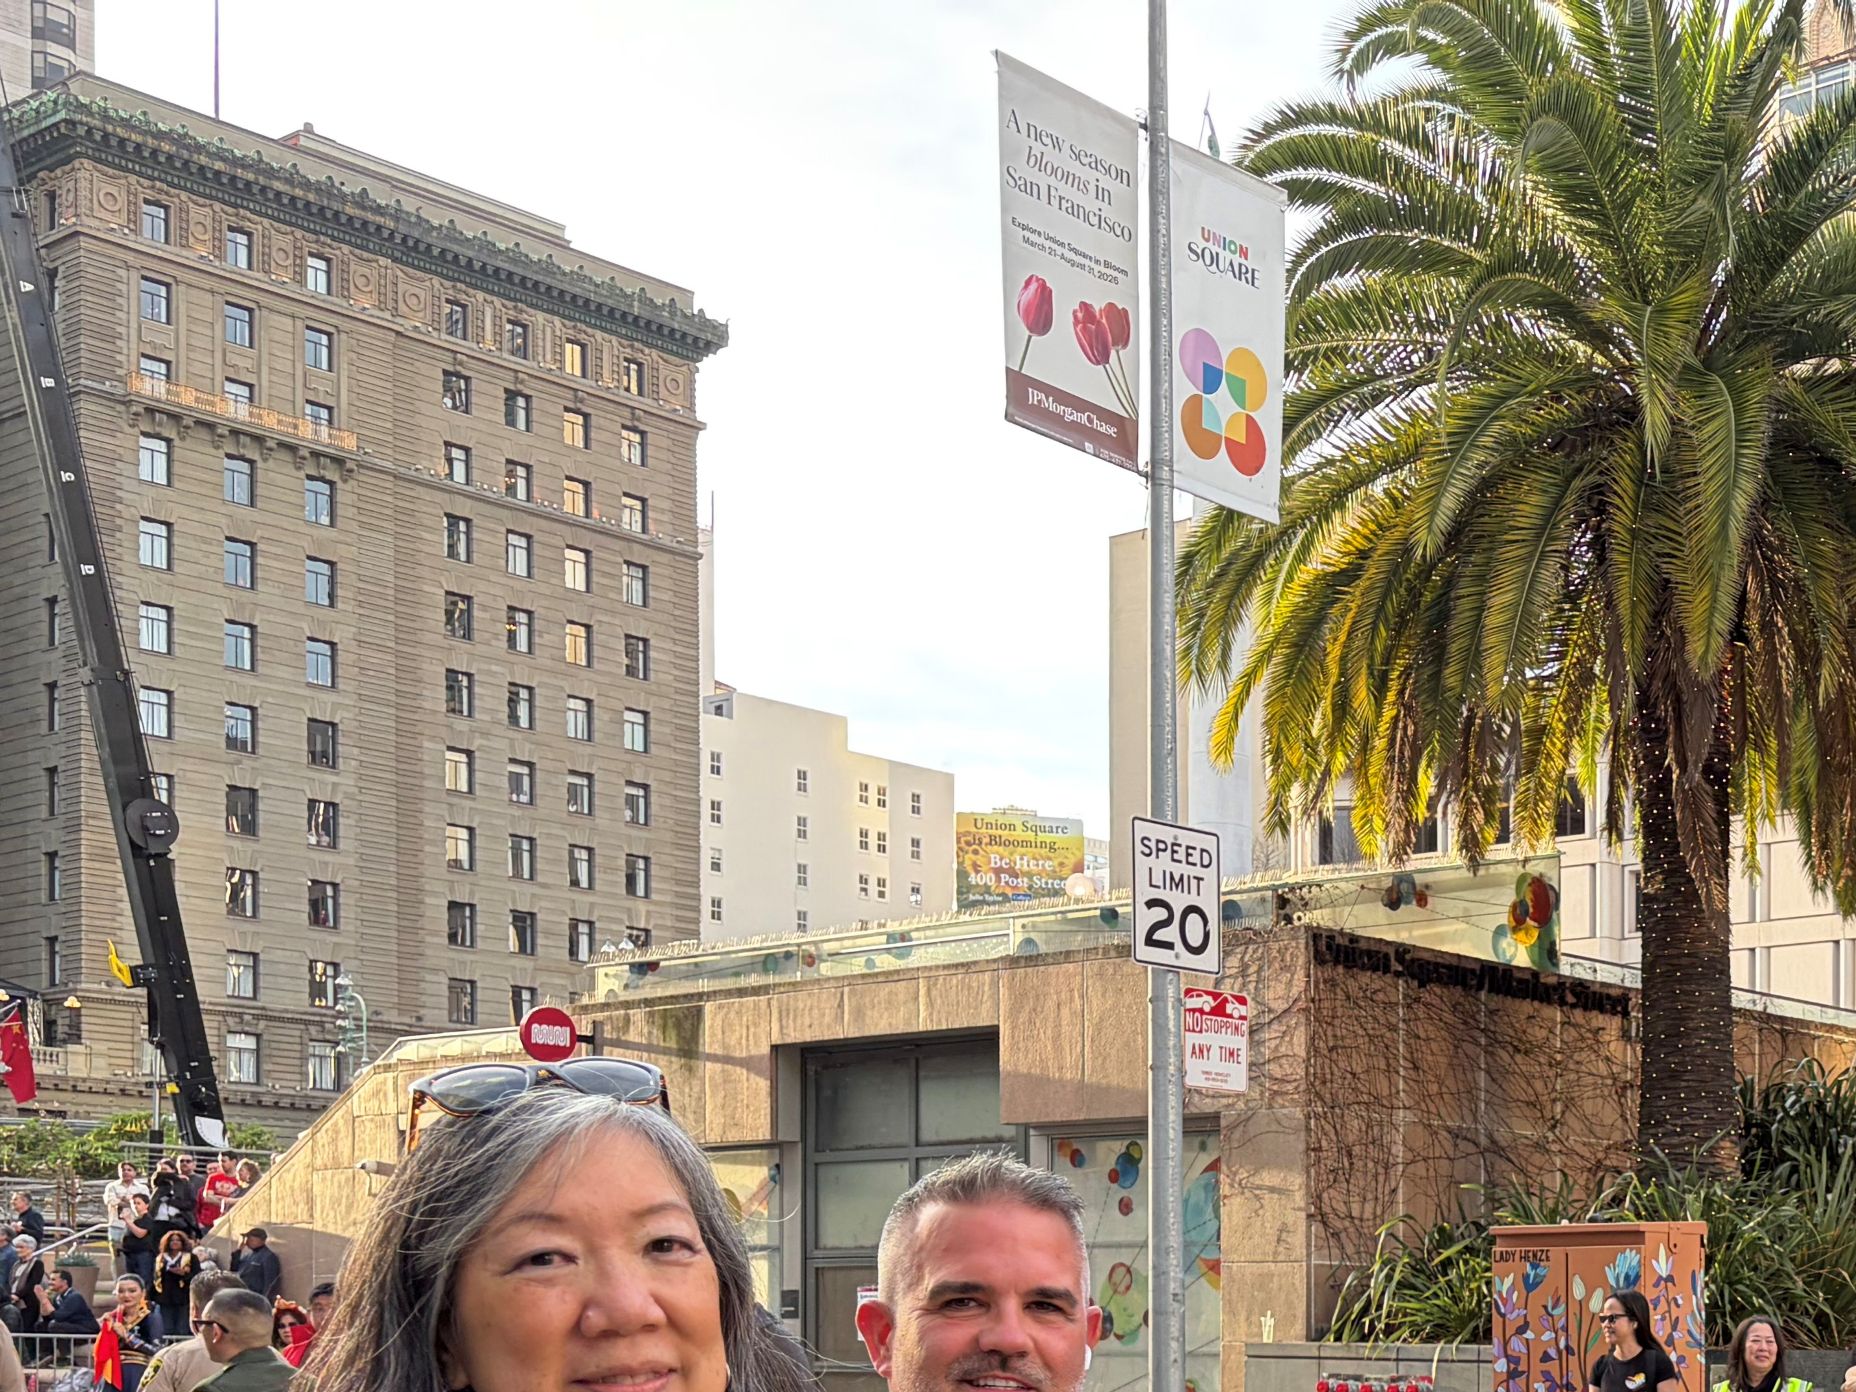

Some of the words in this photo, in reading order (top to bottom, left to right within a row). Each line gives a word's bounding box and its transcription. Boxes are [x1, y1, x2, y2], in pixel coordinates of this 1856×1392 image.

[1006, 108, 1021, 135] A
[1026, 121, 1065, 153] new
[1069, 143, 1131, 188] season
[1026, 145, 1090, 195] blooms
[1095, 178, 1112, 206] in
[1006, 165, 1041, 201] San
[1047, 183, 1132, 243] Francisco
[1011, 216, 1042, 238] Explore
[1043, 231, 1066, 250] Union
[1067, 242, 1093, 263] Square
[1094, 255, 1101, 266] in
[1103, 259, 1129, 278] Bloom
[1022, 234, 1047, 254] March
[1200, 225, 1249, 261] UNION
[1187, 240, 1260, 290] SQUARE
[1027, 386, 1118, 439] JPMorganChase
[972, 834, 982, 846] is
[973, 817, 1016, 832] Union
[1021, 820, 1069, 836] Square
[990, 853, 1010, 869] Be
[1015, 855, 1054, 870] Here
[1140, 836, 1213, 869] SPEED
[968, 872, 995, 887] 400
[1000, 874, 1029, 888] Post
[1033, 875, 1067, 889] Stree
[1148, 866, 1205, 896] LIMIT
[1143, 898, 1211, 956] 20
[1185, 1011, 1201, 1032] NO
[1203, 1018, 1246, 1038] STOPPING
[1190, 1042, 1211, 1061] ANY
[1218, 1045, 1242, 1065] TIME
[1493, 1249, 1516, 1263] LADY
[1519, 1249, 1551, 1263] HENZE
